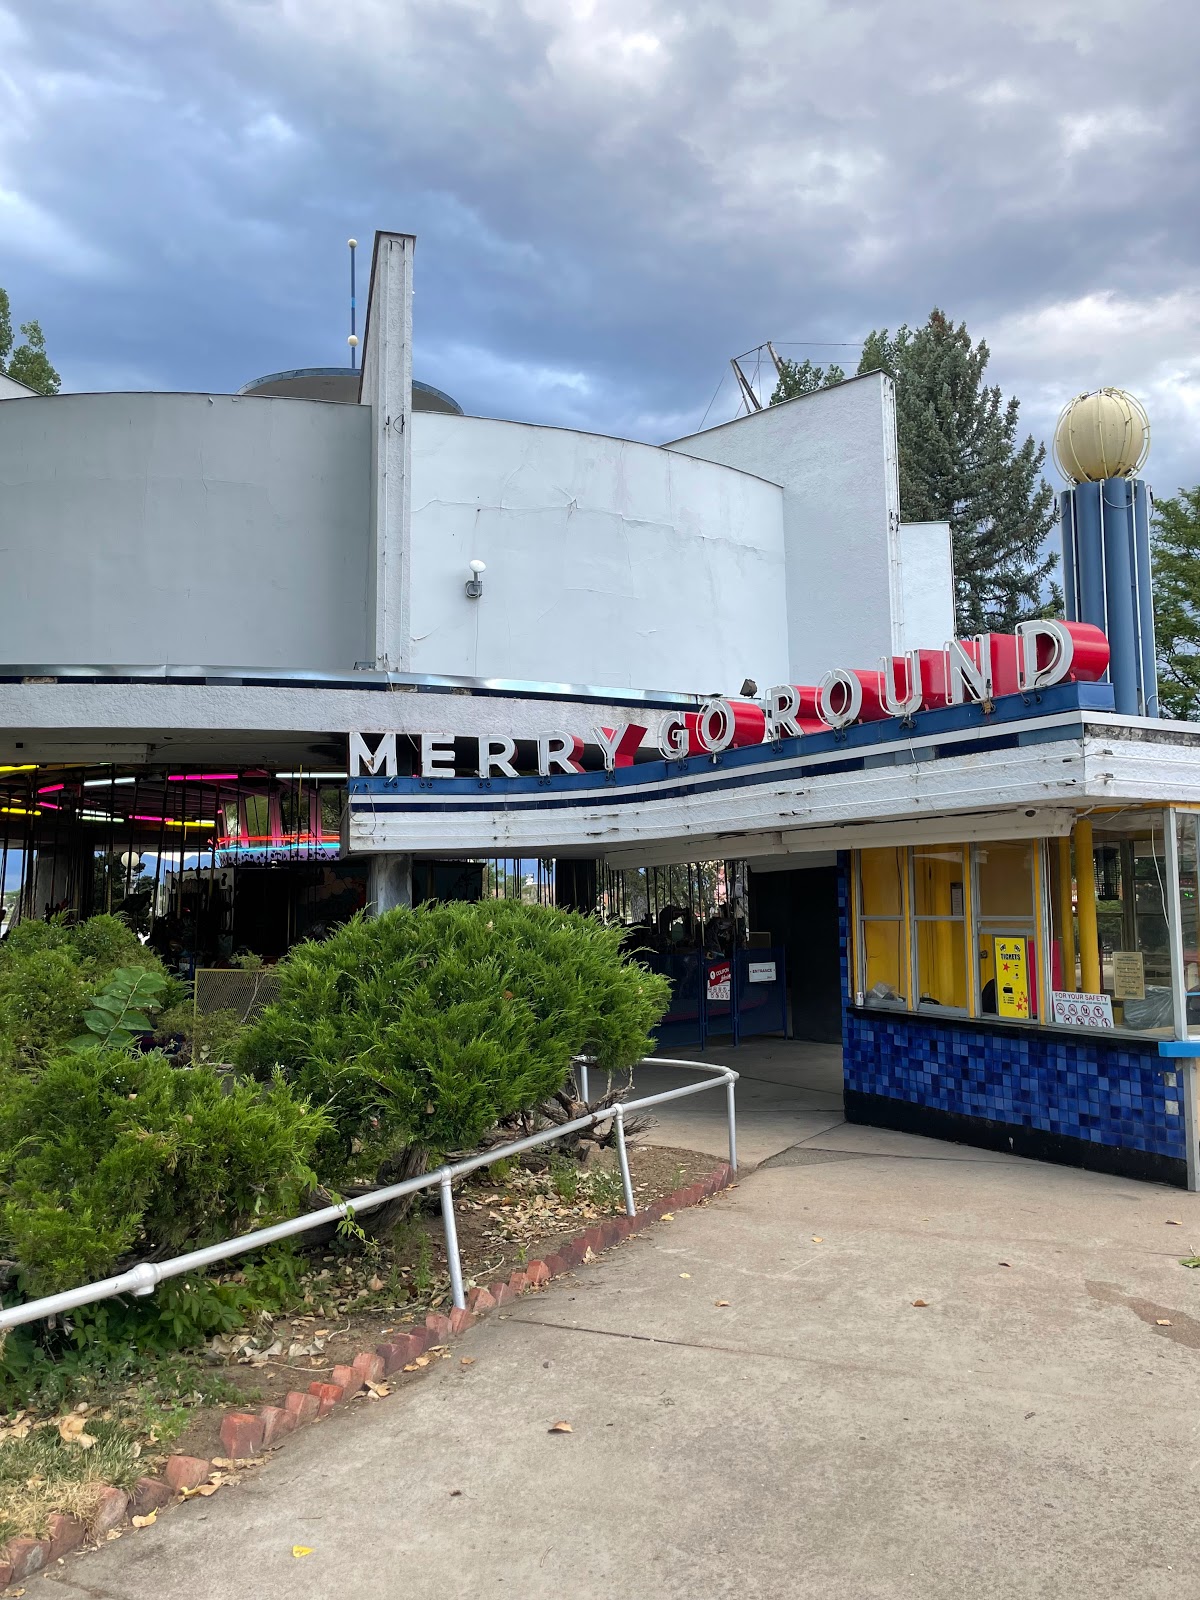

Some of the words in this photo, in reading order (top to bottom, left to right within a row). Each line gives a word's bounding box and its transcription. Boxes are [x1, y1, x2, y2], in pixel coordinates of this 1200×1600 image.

[349, 723, 625, 778] MERRY
[658, 700, 735, 761] GO
[765, 619, 1075, 739] ROUND
[1000, 953, 1021, 961] TICKETS
[1084, 994, 1108, 1002] SAFETY
